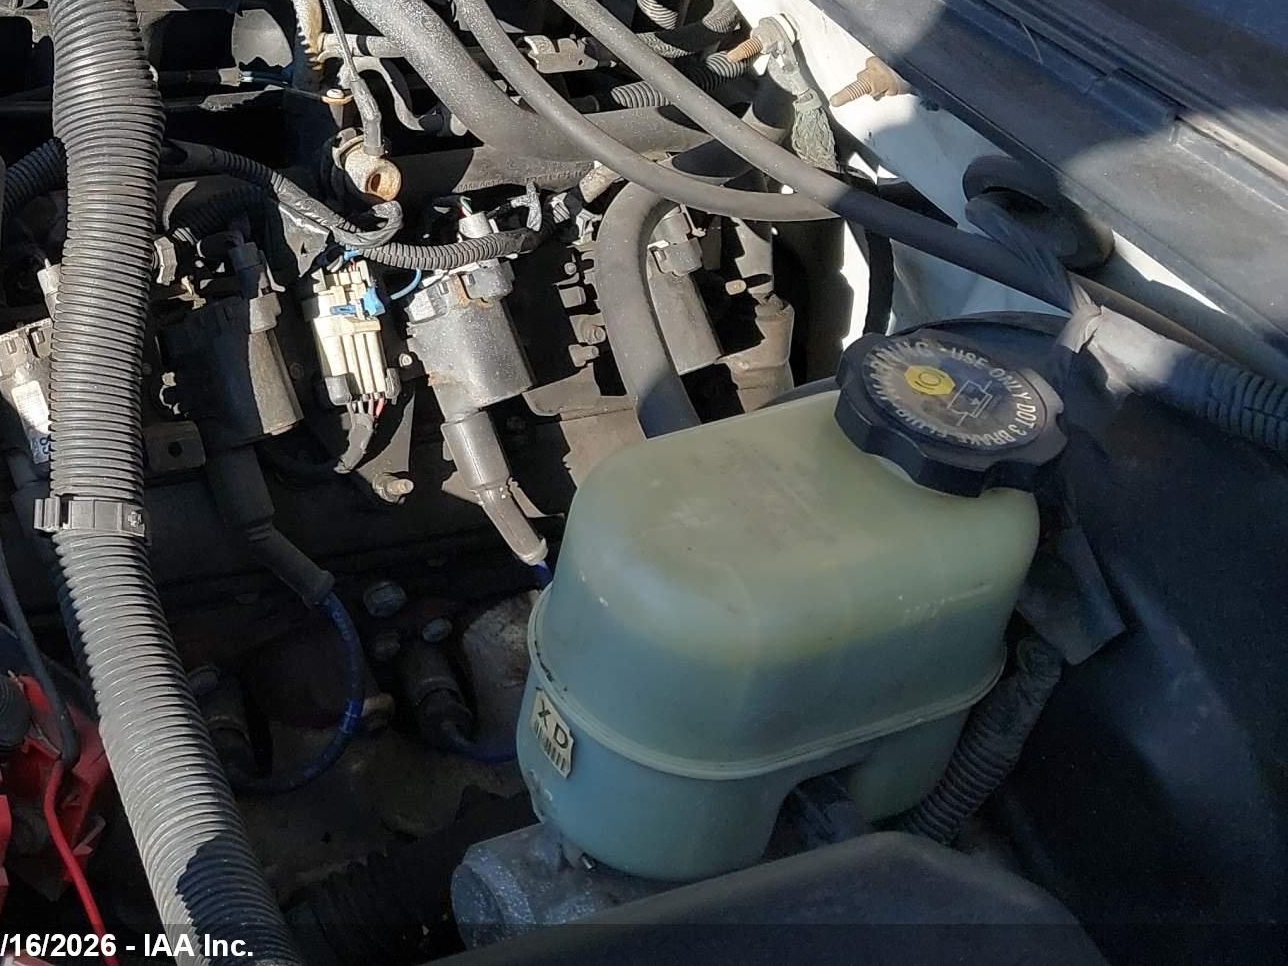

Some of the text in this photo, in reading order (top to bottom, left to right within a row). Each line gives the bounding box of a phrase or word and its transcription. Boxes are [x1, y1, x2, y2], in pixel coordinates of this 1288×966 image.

[951, 346, 989, 370] USE
[988, 367, 1032, 401] ONLY
[1015, 402, 1038, 430] DOT
[958, 429, 1018, 448] BRAKE
[1007, 423, 1028, 438] 3
